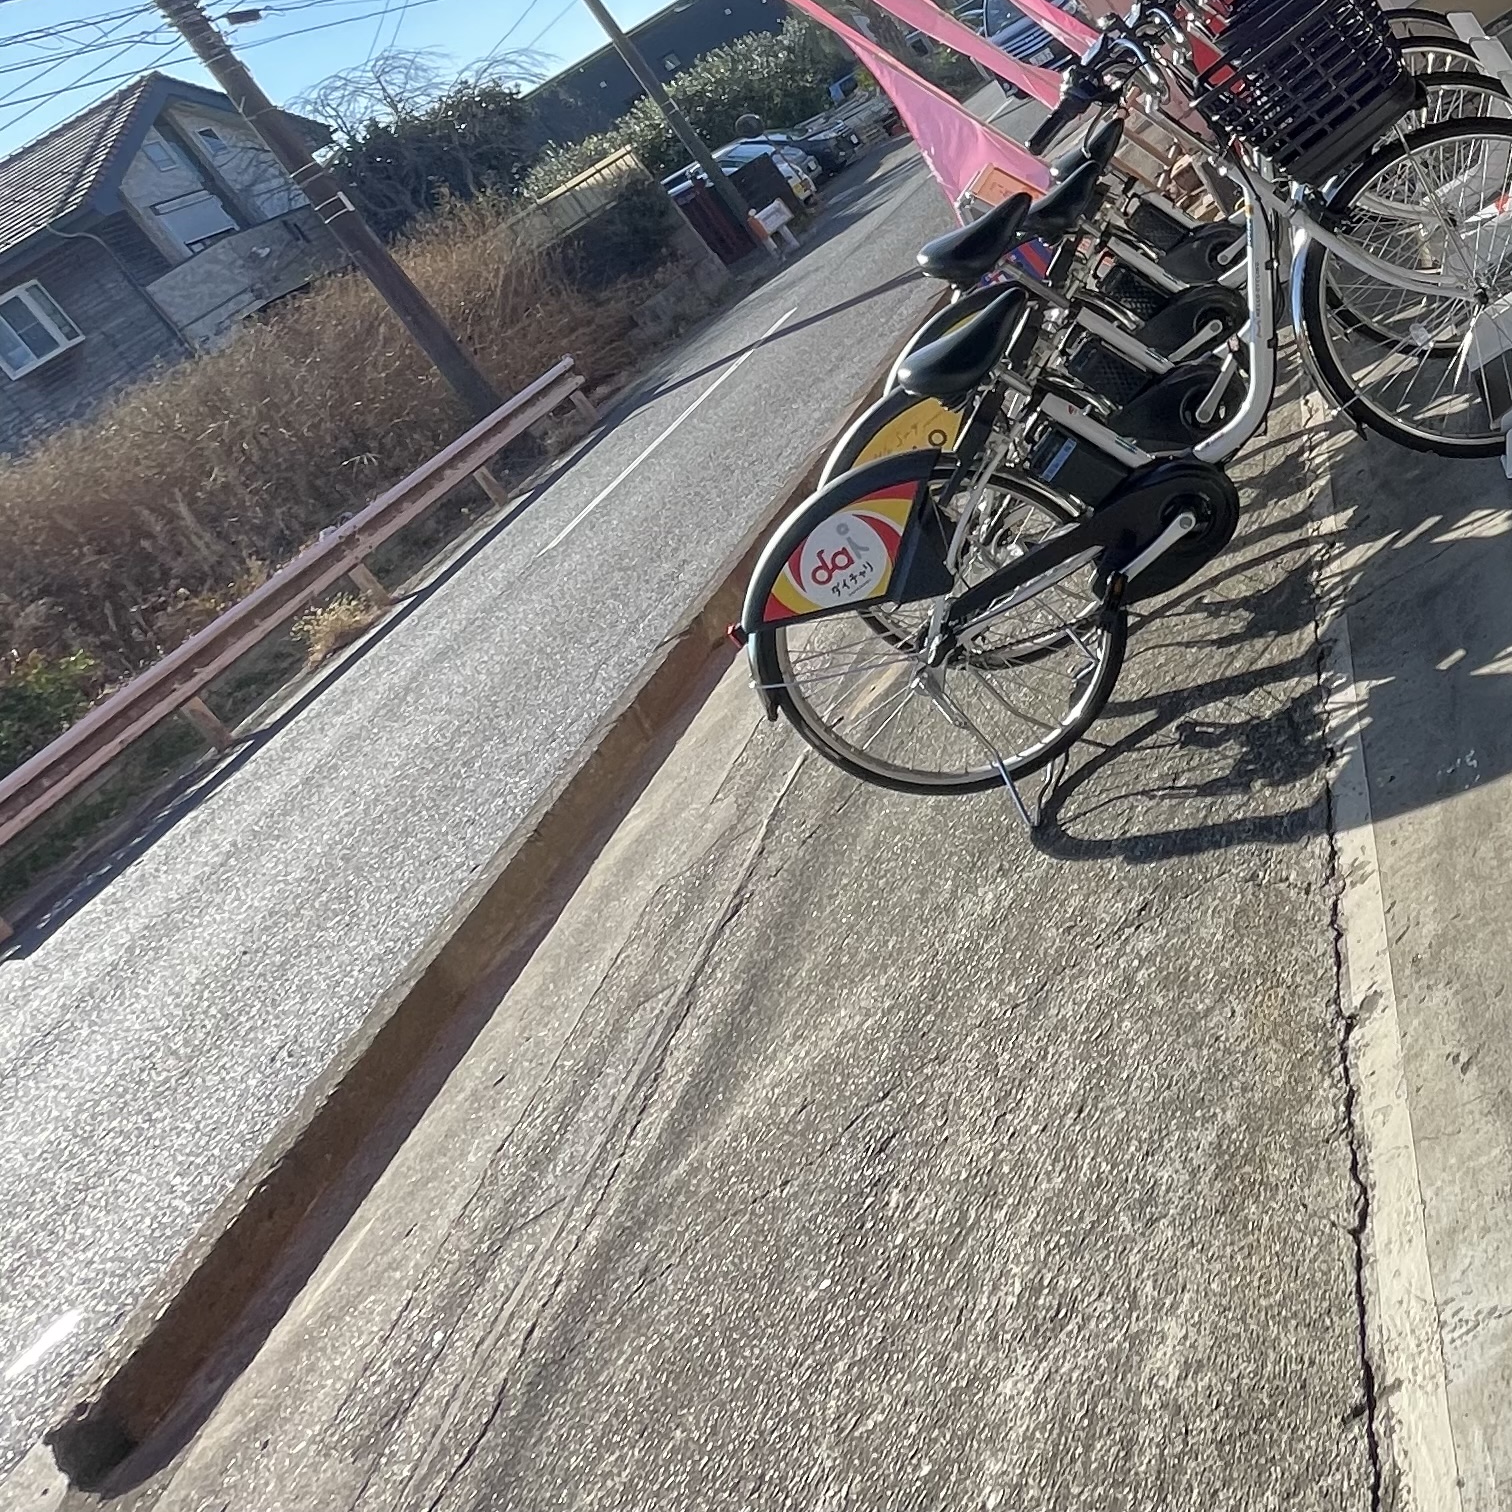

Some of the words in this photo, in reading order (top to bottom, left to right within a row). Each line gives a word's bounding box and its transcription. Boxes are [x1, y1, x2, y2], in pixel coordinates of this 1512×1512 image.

[829, 560, 875, 597] ダイチャリ
